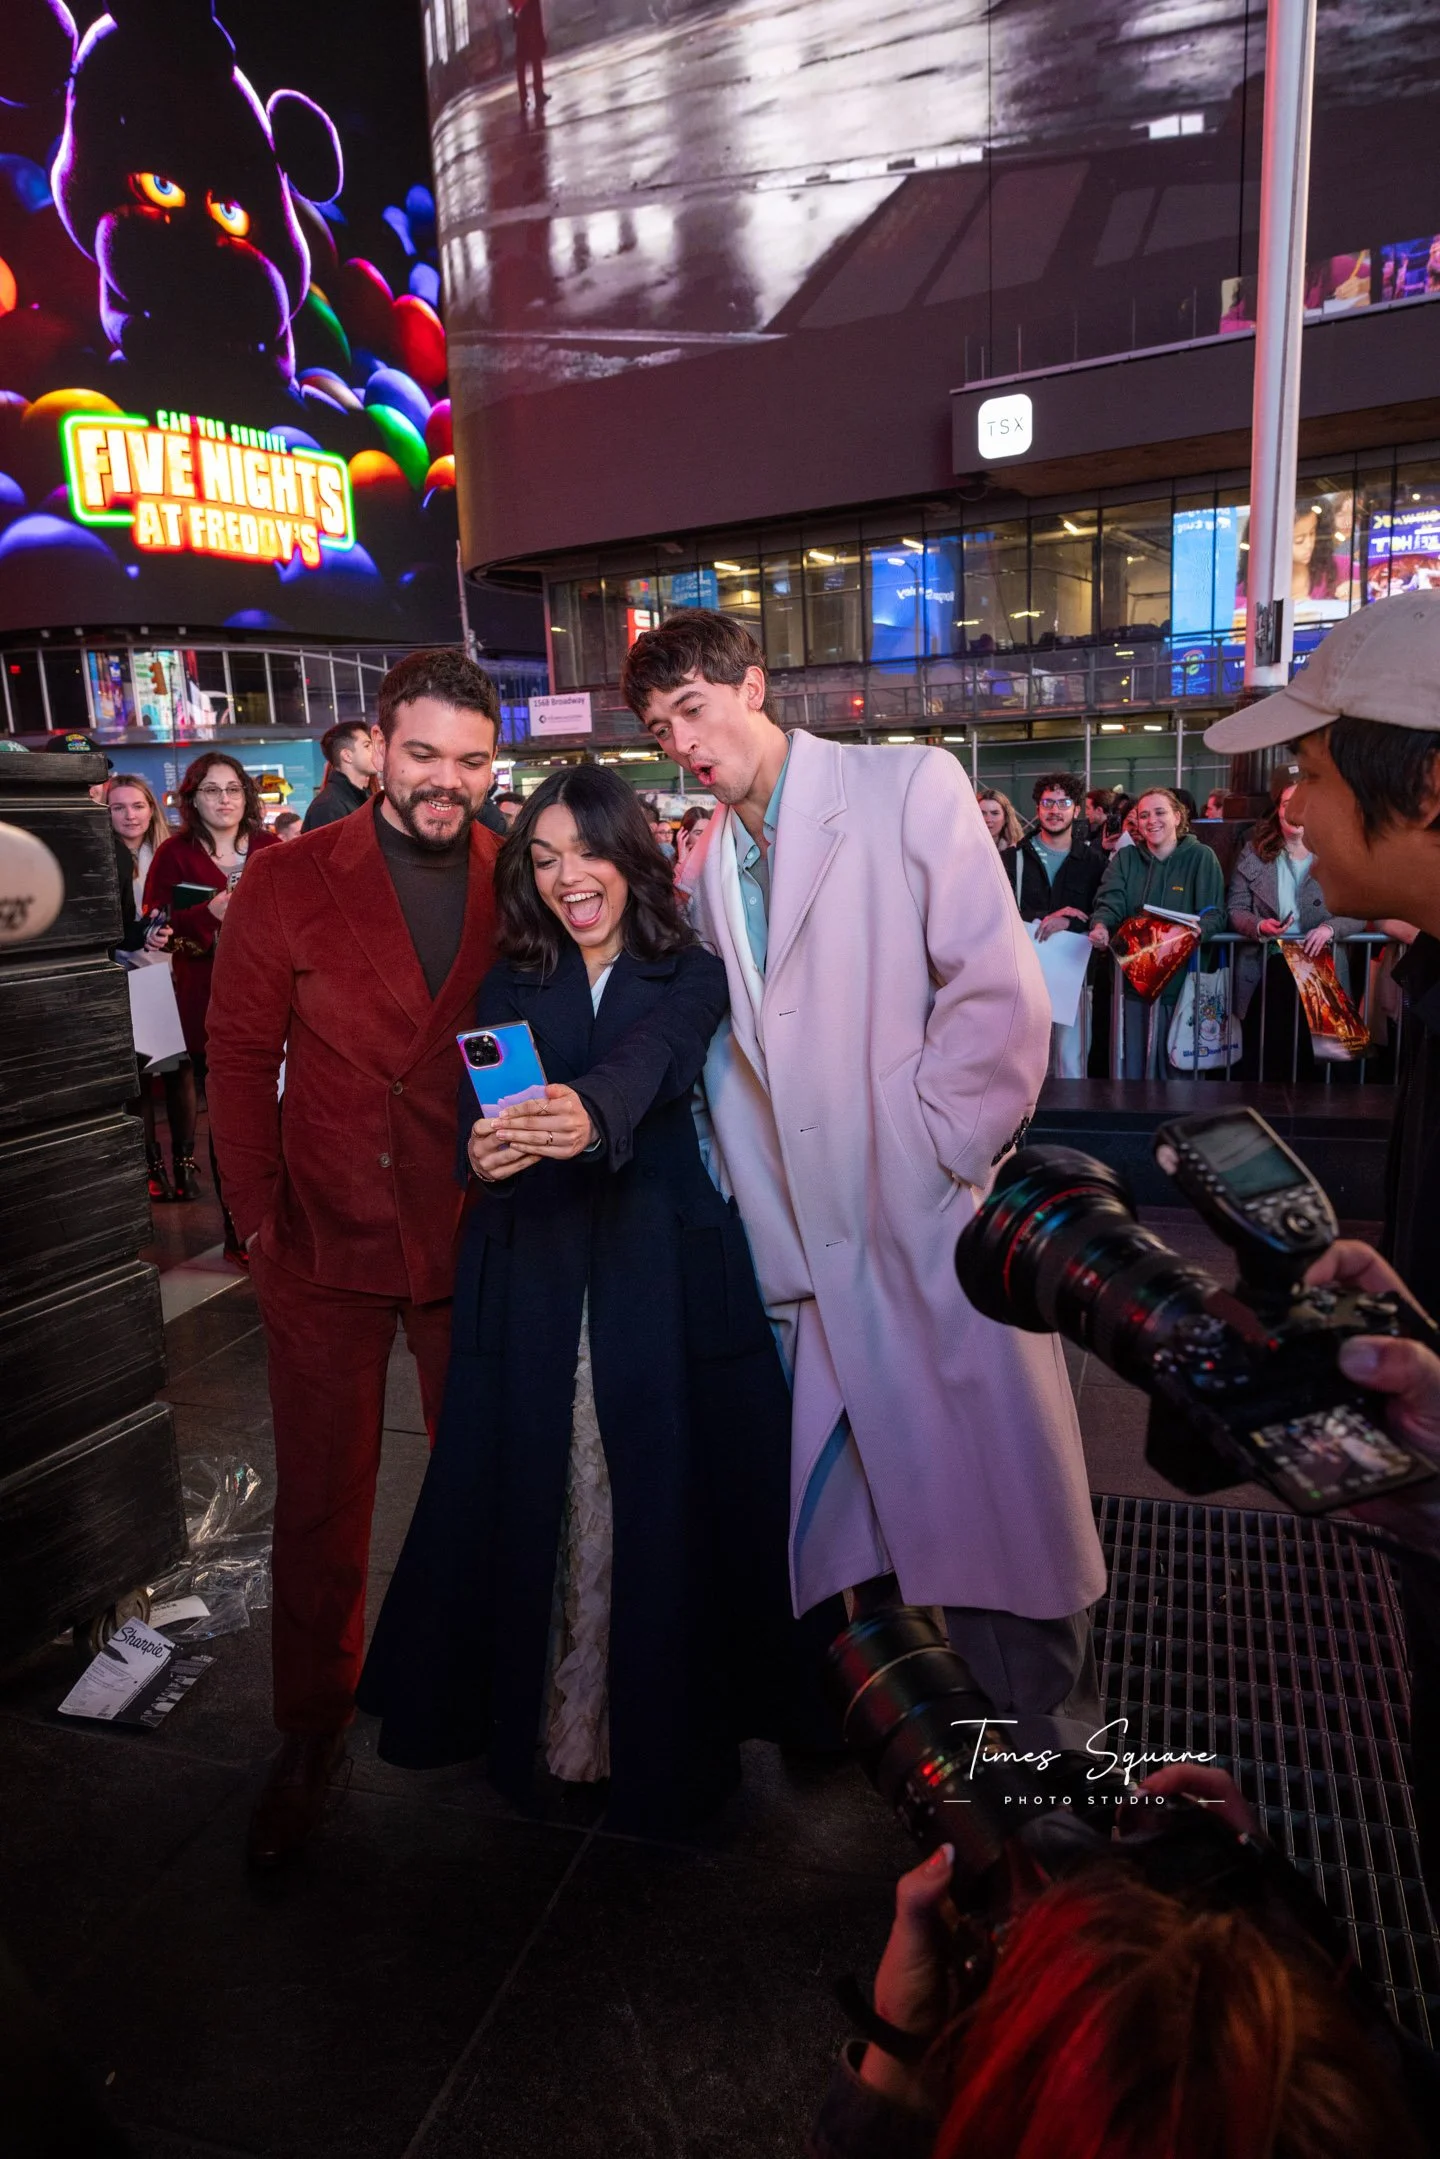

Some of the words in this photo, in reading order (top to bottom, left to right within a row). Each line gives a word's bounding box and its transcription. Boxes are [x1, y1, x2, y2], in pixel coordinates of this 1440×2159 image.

[196, 416, 226, 442] YOU
[230, 423, 287, 454] SURVIVE
[986, 415, 1024, 437] TSX
[77, 429, 196, 507] FIVE
[200, 441, 346, 535] NIGHTS
[137, 503, 184, 547] AT
[190, 507, 320, 566] FREDDY'S
[551, 696, 585, 706] Broadway
[111, 1626, 172, 1658] Sharpie
